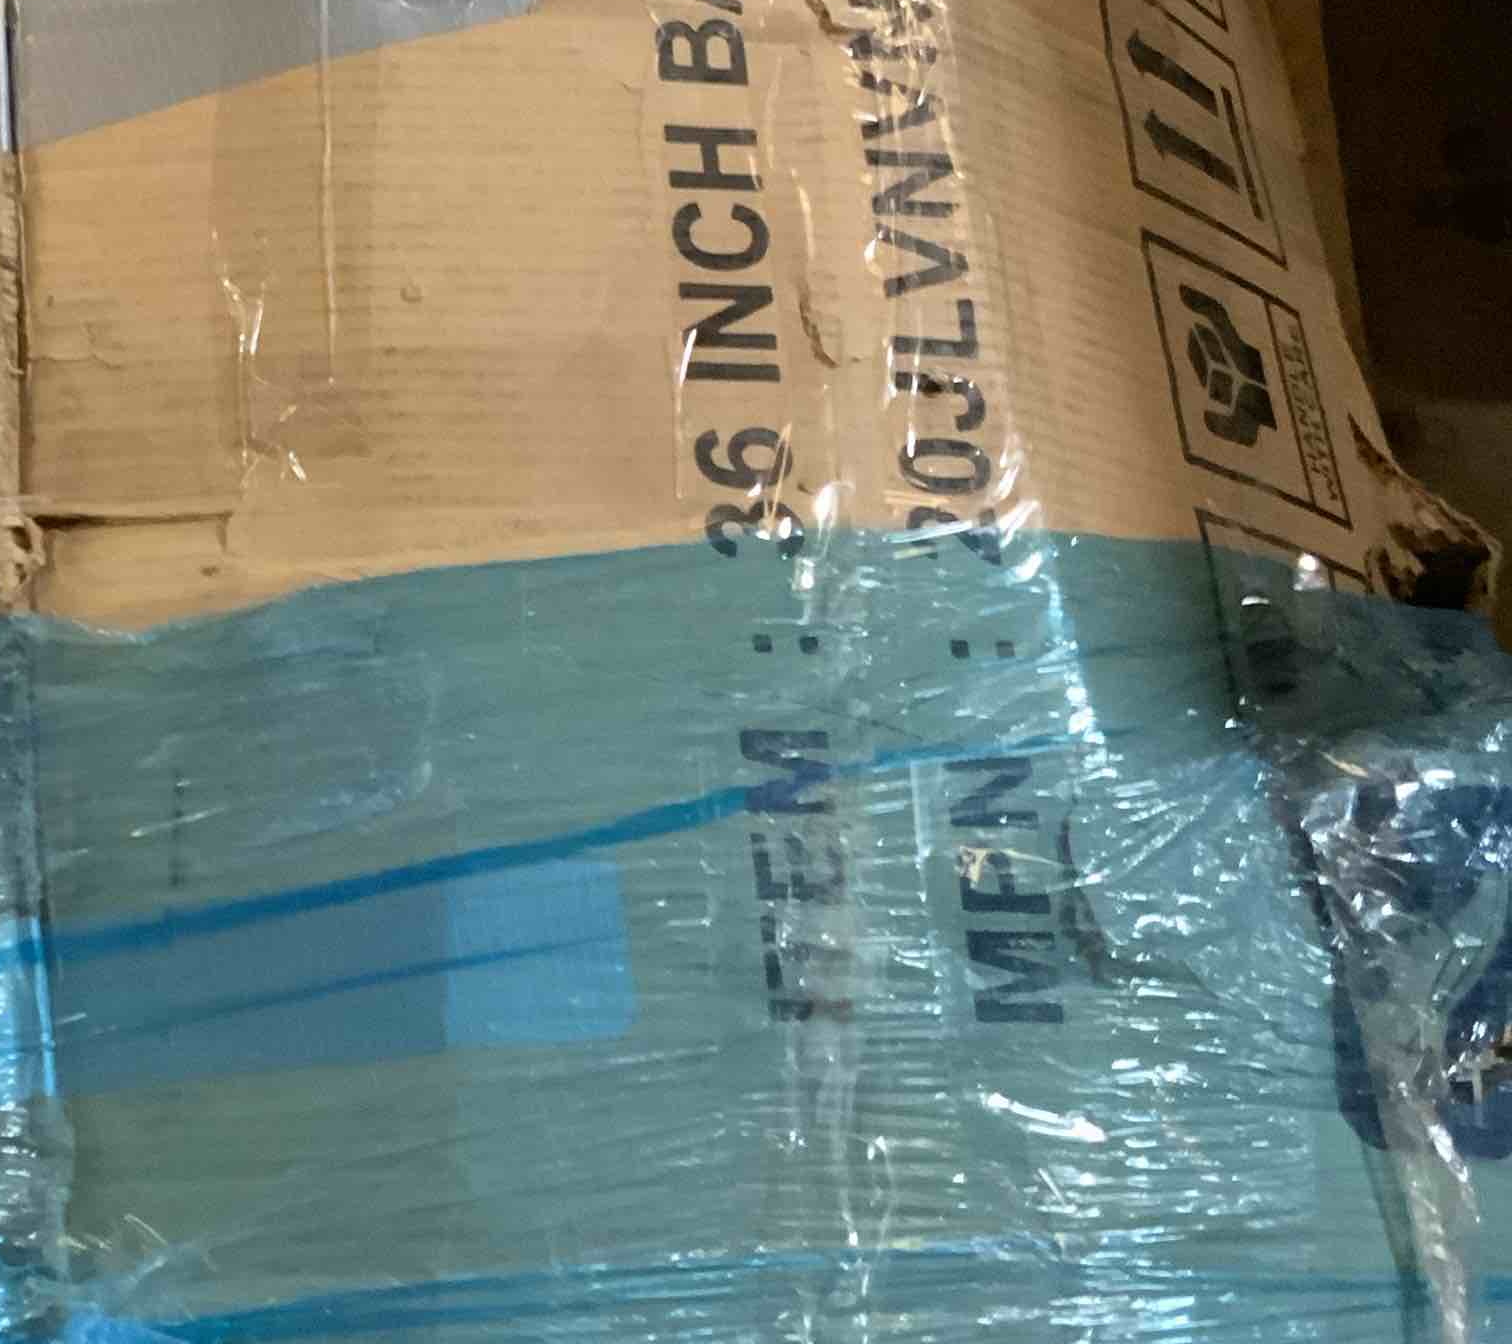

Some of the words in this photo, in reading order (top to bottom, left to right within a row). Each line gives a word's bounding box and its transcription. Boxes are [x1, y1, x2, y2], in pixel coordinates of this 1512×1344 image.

[663, 123, 782, 385] INCH
[694, 426, 806, 559] 36
[738, 728, 855, 1023] ITEM
[944, 756, 1065, 1025] MPN
